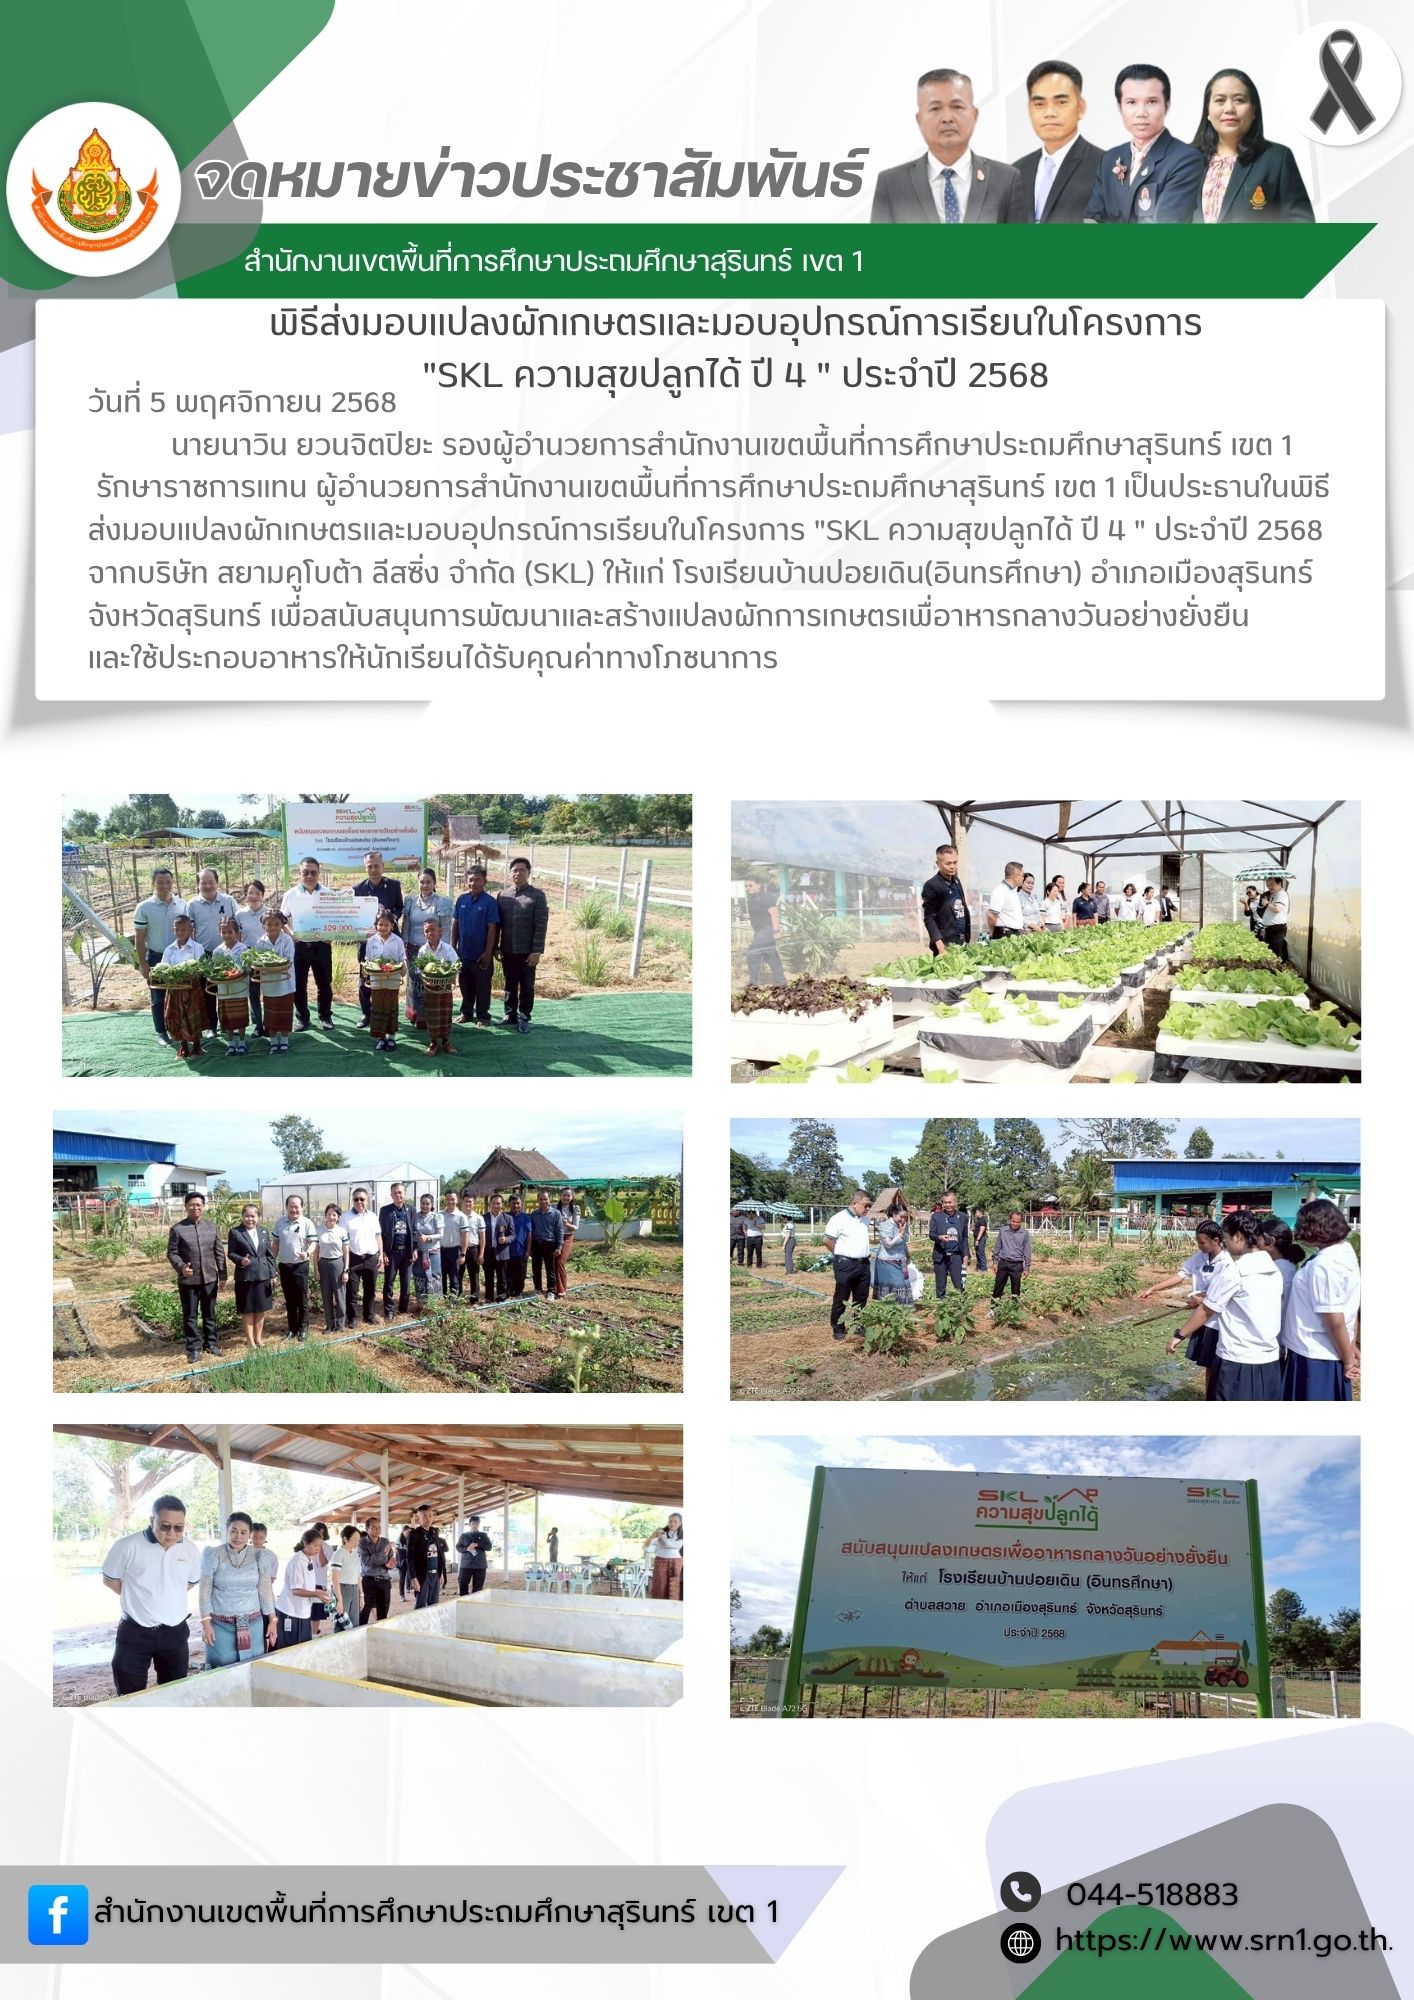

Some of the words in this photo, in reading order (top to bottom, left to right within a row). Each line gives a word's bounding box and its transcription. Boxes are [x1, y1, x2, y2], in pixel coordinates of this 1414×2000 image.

[195, 146, 870, 199] จดหมายข่าวประชาสัมพันธ์
[245, 242, 792, 278] สำนักงานเขตพื้นที่การศึกษาประถมศึกษาสุรินทร์
[804, 253, 843, 272] เขต
[852, 250, 862, 272] 1
[271, 303, 1202, 347] พิธีส่งมอบแปลงผักเกษตรและมอบอุปกรณ์การเรียนในโครงการ
[424, 362, 503, 388] "SKL
[515, 357, 742, 398] ความสุขปลูกได้
[750, 357, 772, 388] ปี
[785, 362, 807, 388] 4
[843, 357, 956, 388] ประจำปี
[968, 362, 1048, 388] 2568
[88, 383, 141, 413] วันที่
[150, 391, 166, 413] 5
[176, 390, 321, 420] พฤศจิกายน
[331, 391, 396, 413] 2568
[172, 433, 286, 456] นายนาวิน
[297, 430, 433, 456] ยวนจิตปิยะ
[442, 423, 1222, 465] รองผู้อำนวยการสำนักงานเขตพื้นที่การศึกษาประถมศึกษาสุรินทร์
[1232, 437, 1272, 456] เขต
[1281, 434, 1291, 456] 1
[97, 472, 306, 498] รักษาราชการแทน
[317, 466, 1046, 507] ผู้อำนวยการสำนักงานเขตพื้นที่การศึกษาประถมศึกษาสุรินทร์
[1055, 479, 1096, 498] เขต
[1105, 476, 1114, 498] 1
[1125, 471, 1330, 498] เป็นประธานในพิธี
[88, 514, 805, 549] ส่งมอบแปลงผักเกษตรและมอบอุปกรณ์การเรียนในโครงการ
[815, 519, 880, 541] "SKL
[889, 515, 1074, 549] ความสุขปลูกได้
[1080, 515, 1098, 541] ปี
[1108, 519, 1126, 541] 4
[1155, 515, 1247, 541] ประจำปี
[1257, 519, 1323, 541] 2568
[88, 558, 207, 584] จากบริษัท
[218, 558, 362, 593] สยามคูโบต้า
[372, 553, 439, 584] ลีสซิ่ง
[449, 558, 515, 584] จำกัด
[525, 560, 594, 587] (SKL)
[602, 556, 664, 584] ให้แก่
[672, 558, 1081, 587] โรงเรียนบ้านปอยเดิน(อินทรศึกษา)
[1091, 558, 1314, 593] อำเภอเมืองสุรินทร์
[88, 601, 262, 635] จังหวัดสุรินทร์
[271, 594, 1248, 635] เพื่อสนับสนุนการพัฒนาและสร้างแปลงผักการเกษตรเพื่ออาหารกลางวันอย่างยั่งยืน
[89, 641, 778, 678] และใช้ประกอบอาหารให้นักเรียนได้รับคุณค่าทางโภชนาการ
[977, 1489, 1038, 1503] SKL
[1187, 1486, 1240, 1499] SKL
[976, 1500, 1099, 1526] ความสุขปลูกได้
[841, 1538, 1229, 1566] สนับสนุนแปลงเกษตรเพื่ออาหารกลางวันอย่างยั่งยืน
[902, 1570, 929, 1584] ให้แก่
[938, 1568, 1080, 1587] โรงเรียนบ้านปอยเดิน
[1086, 1574, 1173, 1592] (อินทรศึกษา)
[904, 1597, 967, 1612] ตำบลสวาย
[975, 1599, 1077, 1617] อำเภอเมืองสุรินทร์
[1086, 1602, 1163, 1620] จังหวัดสุรินทร์
[1003, 1626, 1038, 1639] ประจำปี
[1041, 1628, 1066, 1639] 2568
[95, 1891, 697, 1931] สำนักงานเขตพื้นที่การศึกษาประถมศึกษาสุรินทร์
[708, 1902, 754, 1924] เขต
[767, 1900, 778, 1923] 1
[1067, 1882, 1239, 1907] 044-518883
[1056, 1926, 1394, 1958] https://www.srn1.go.th.
